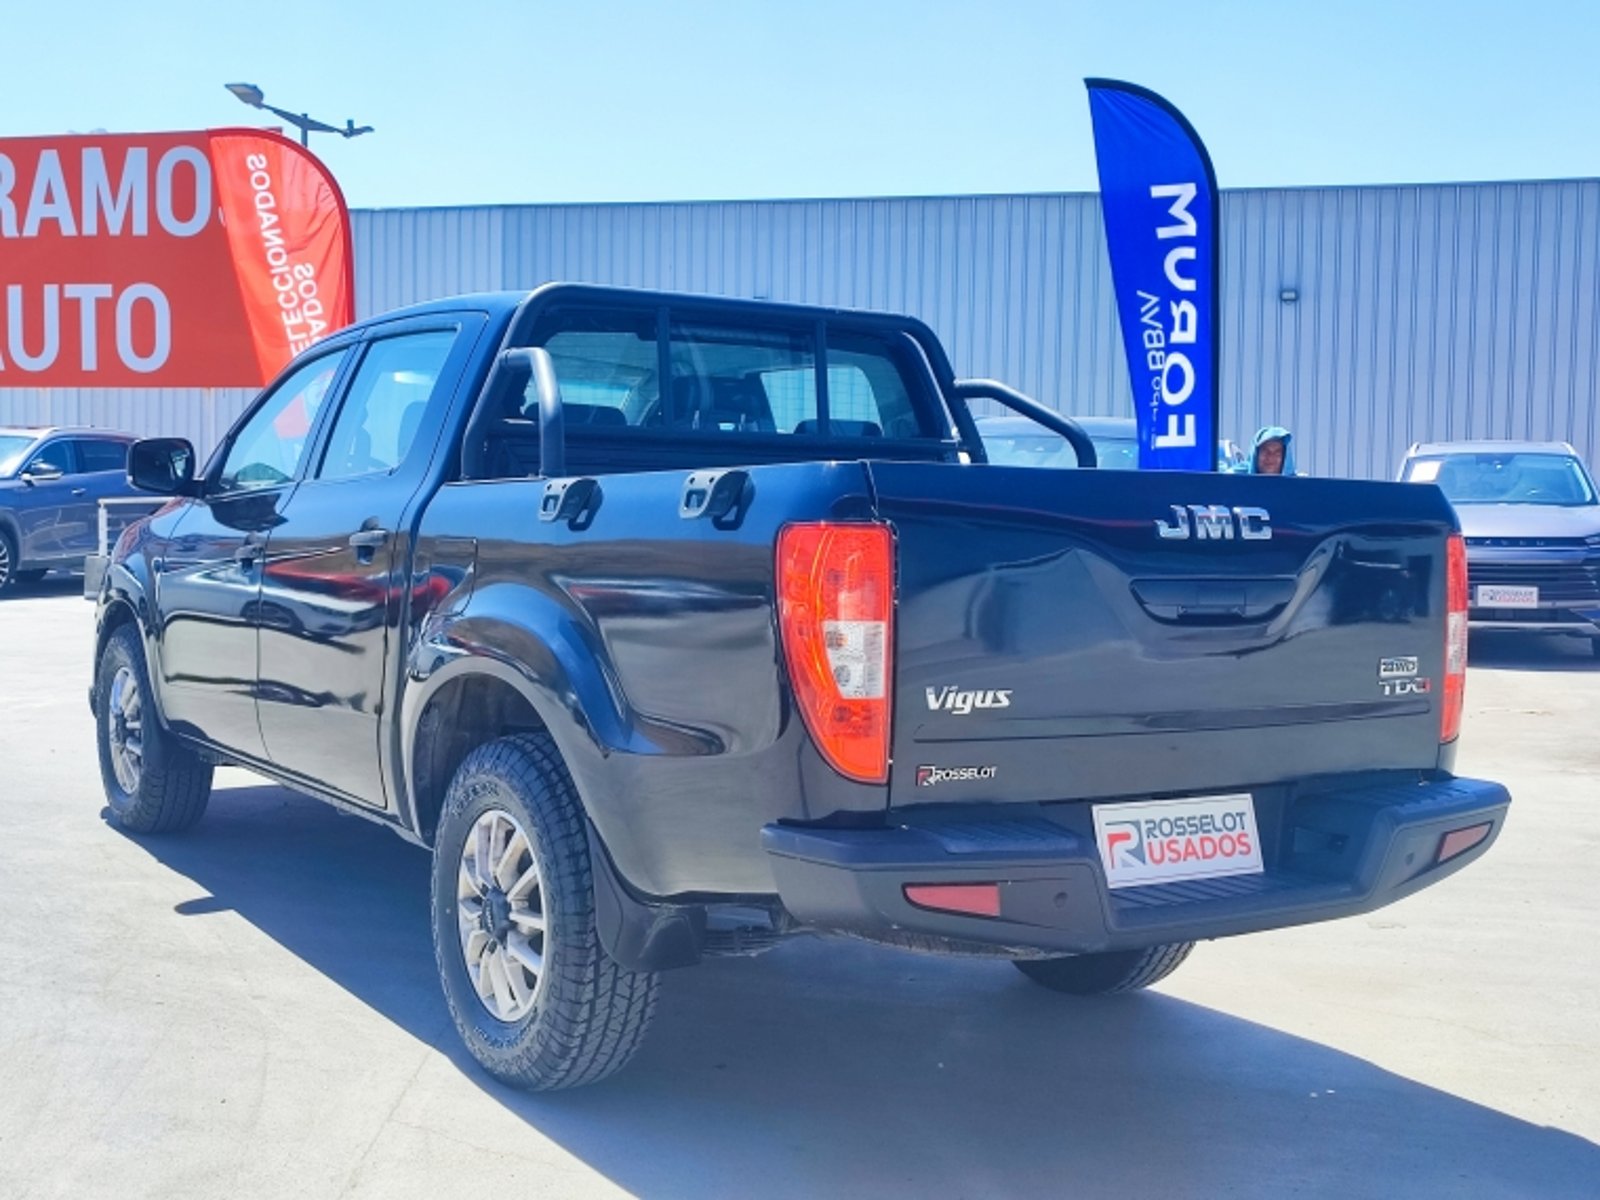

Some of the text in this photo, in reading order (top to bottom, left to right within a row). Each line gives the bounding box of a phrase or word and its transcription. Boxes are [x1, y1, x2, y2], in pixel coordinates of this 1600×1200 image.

[0, 145, 226, 237] AMO
[0, 282, 172, 373] UTO
[1153, 504, 1273, 540] JMC
[925, 685, 1013, 715] Vigus
[934, 766, 998, 781] ROSSELOT
[1145, 812, 1247, 839] ROSSELOT
[1147, 832, 1252, 865] USADOS
